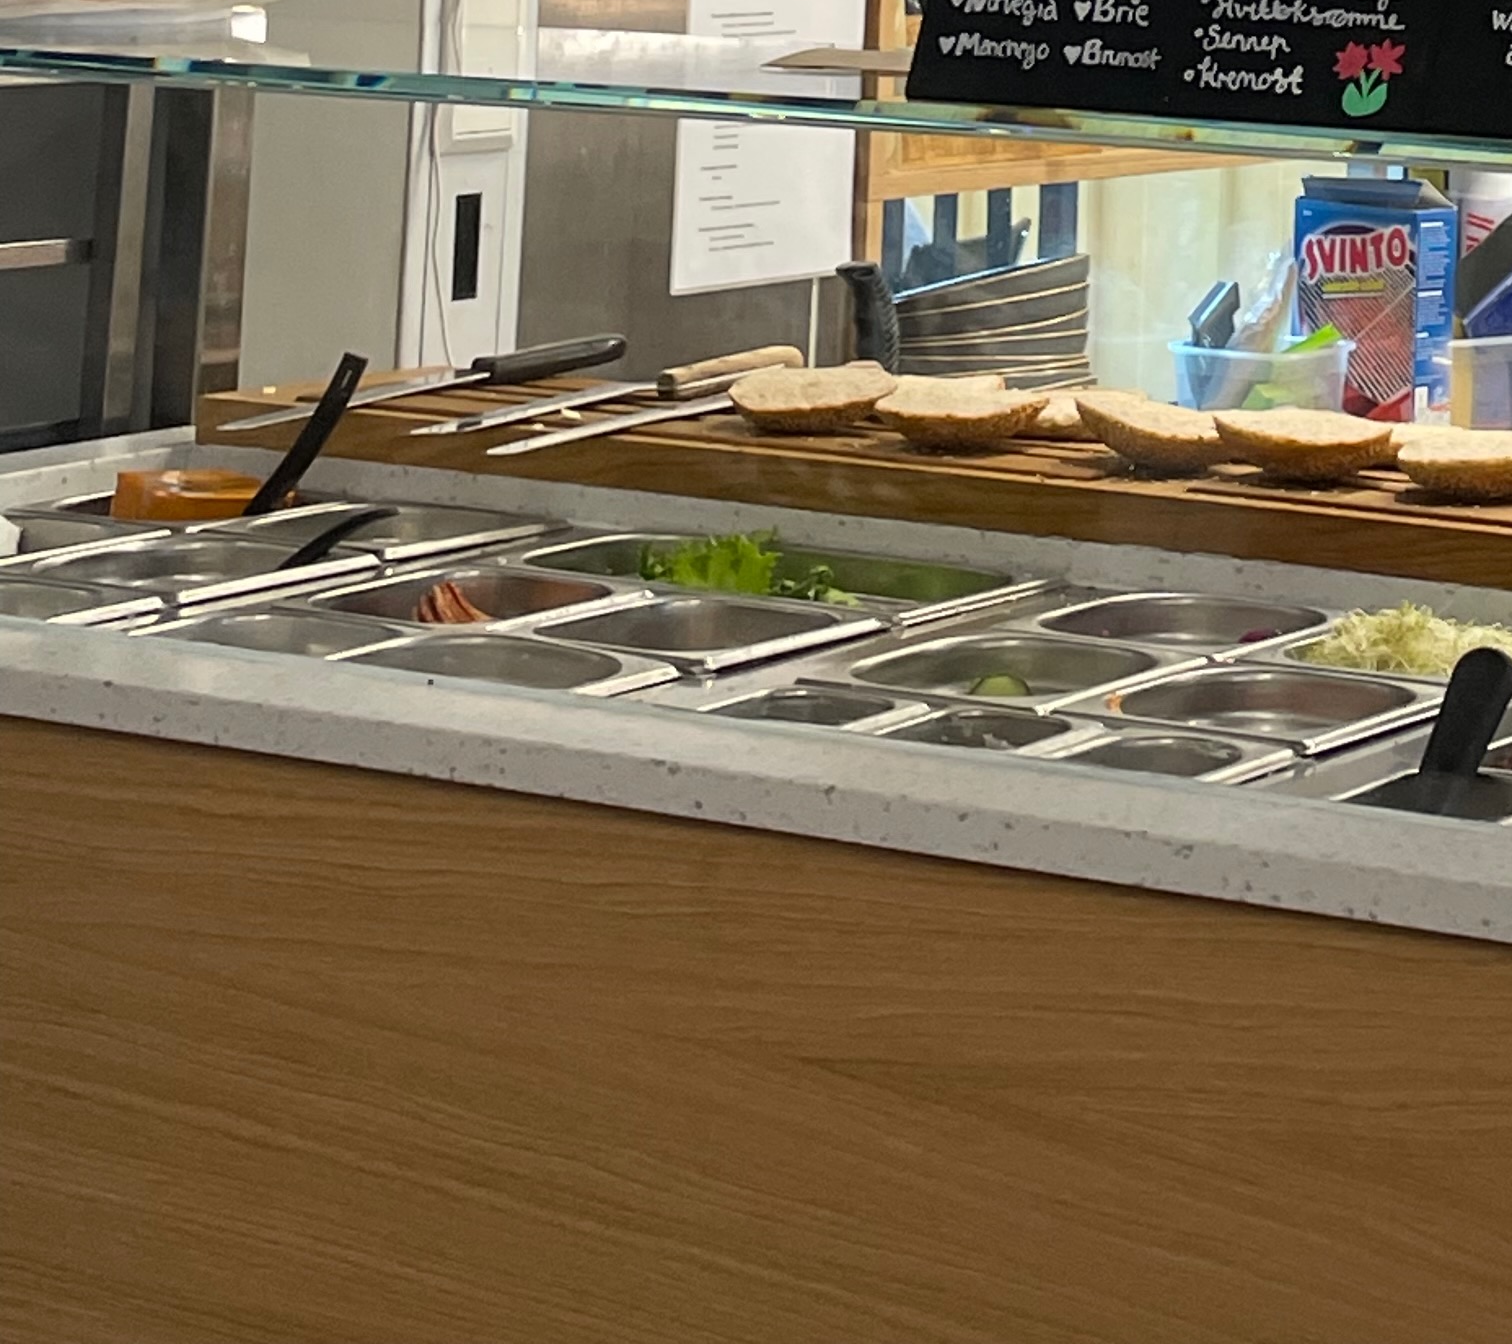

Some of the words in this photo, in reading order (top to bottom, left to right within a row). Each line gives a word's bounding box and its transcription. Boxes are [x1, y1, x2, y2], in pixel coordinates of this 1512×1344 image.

[1202, 23, 1291, 60] Sennep
[1197, 56, 1304, 94] Kremost
[1303, 225, 1410, 283] SVINTO
